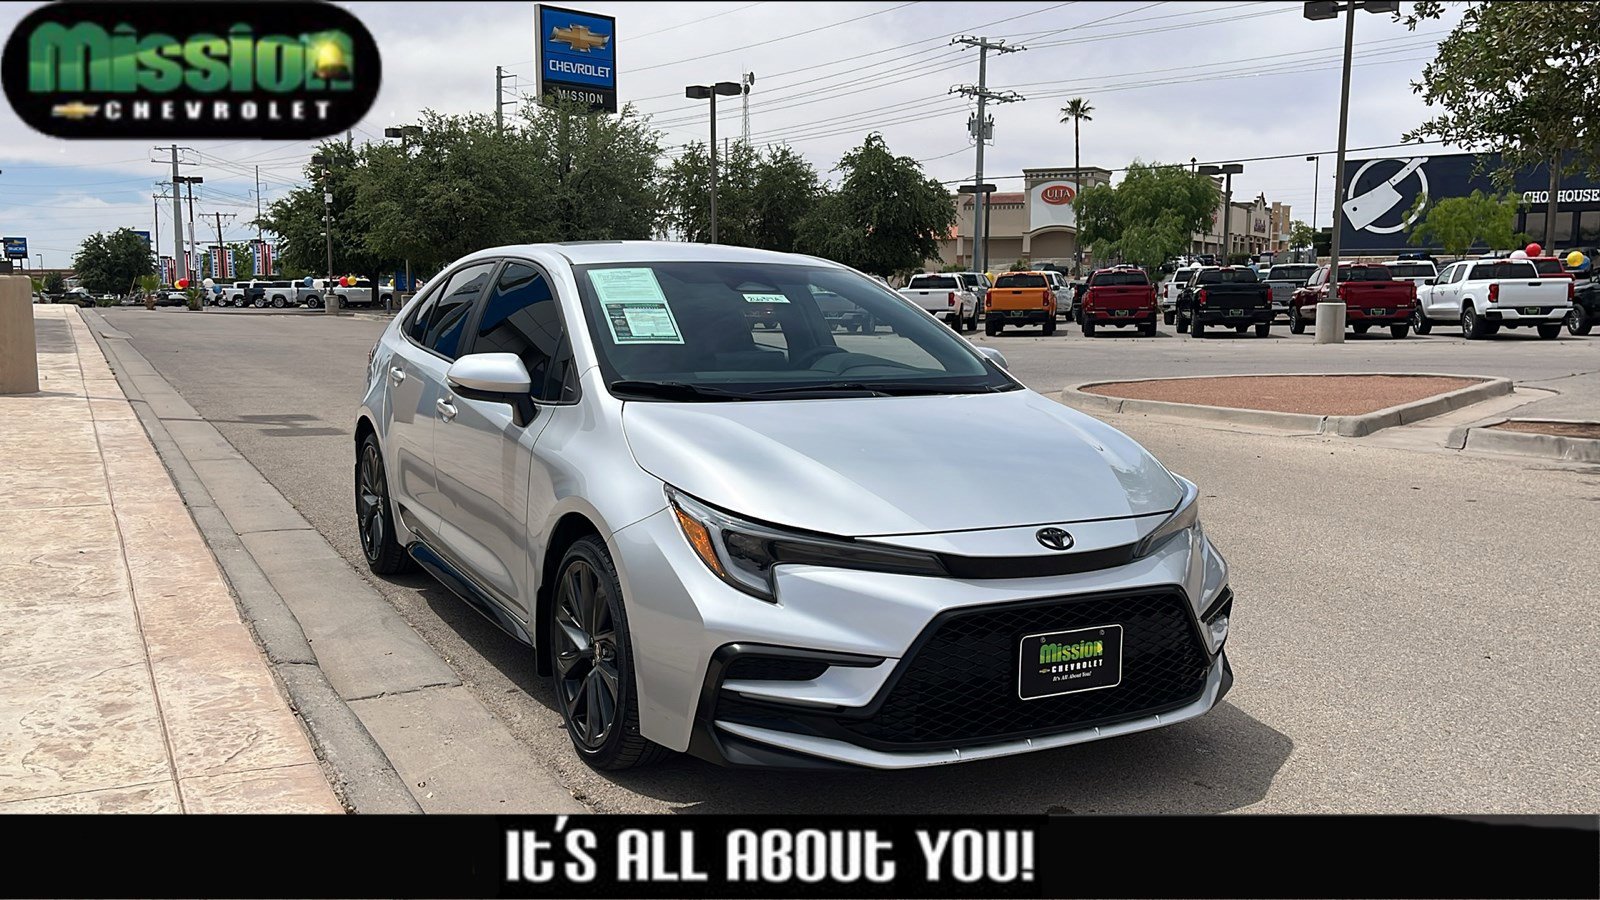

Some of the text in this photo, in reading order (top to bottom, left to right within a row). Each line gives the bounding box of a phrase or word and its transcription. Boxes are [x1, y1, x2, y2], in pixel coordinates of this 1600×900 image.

[549, 59, 611, 78] CHEVROLET
[558, 89, 603, 104] MISSION
[1047, 189, 1071, 198] ULTA
[1523, 189, 1600, 204] CHOHOUSE
[1039, 640, 1103, 664] Mission
[1051, 659, 1103, 673] CHEVROLET
